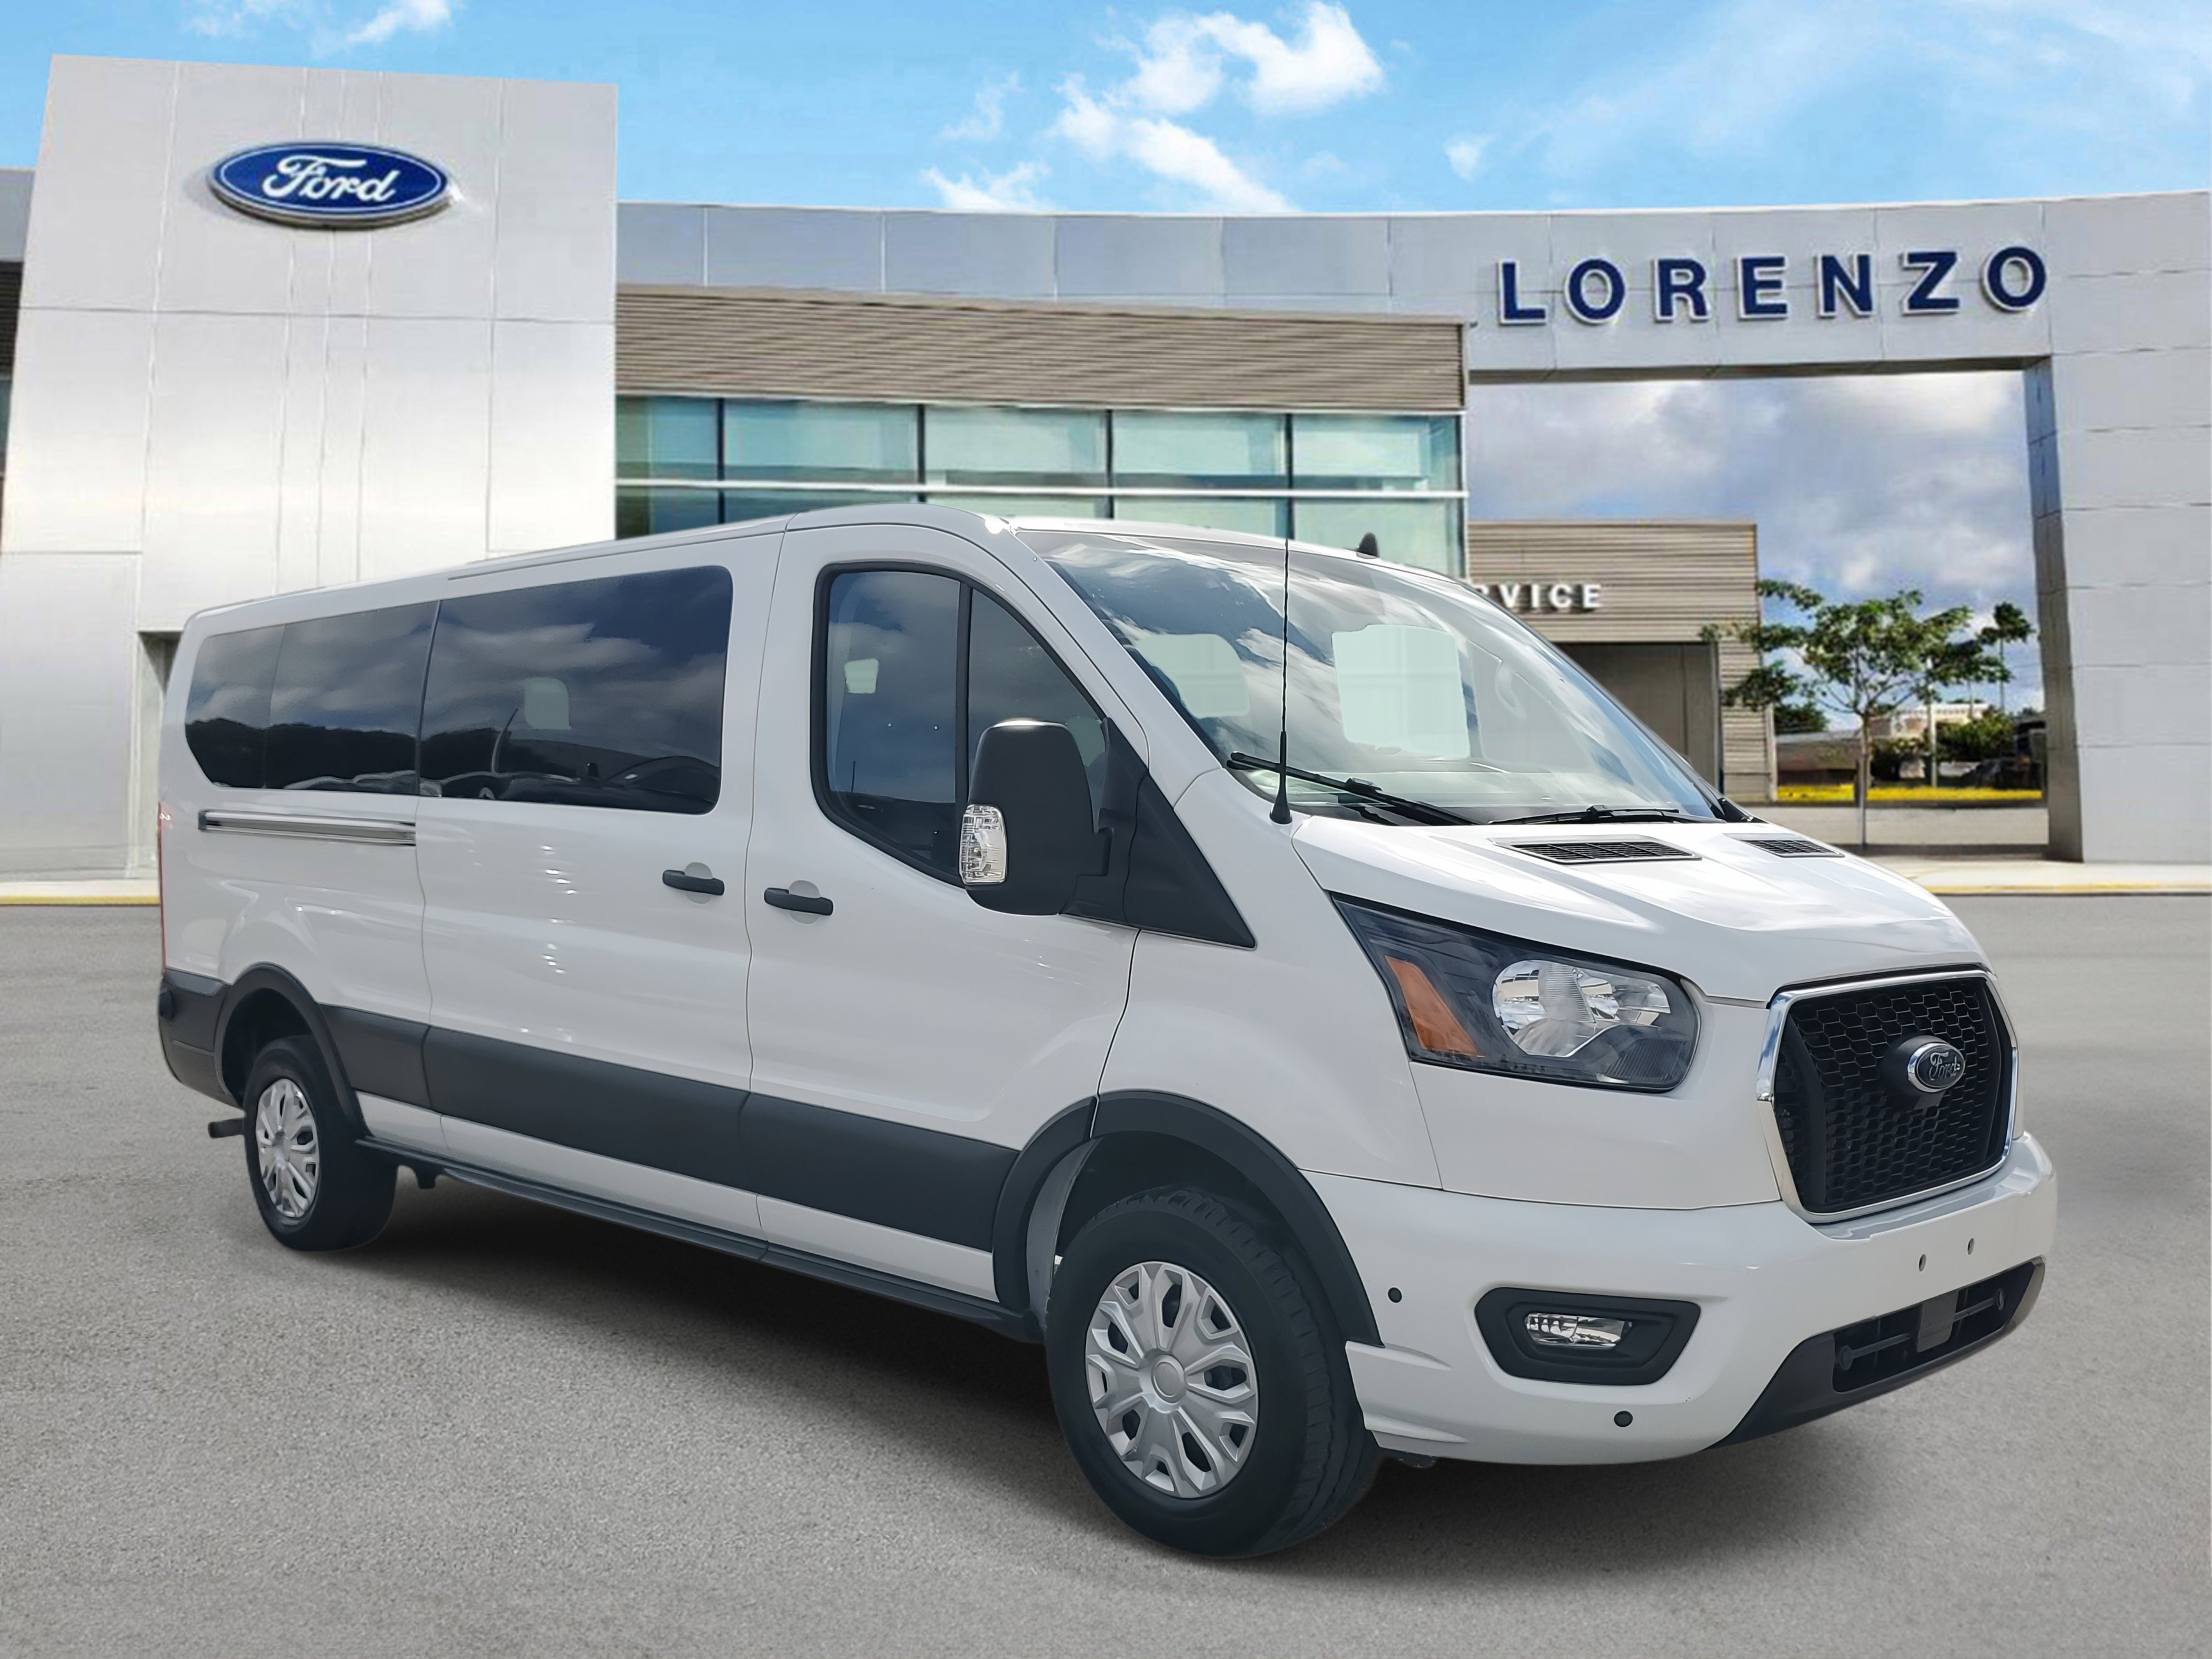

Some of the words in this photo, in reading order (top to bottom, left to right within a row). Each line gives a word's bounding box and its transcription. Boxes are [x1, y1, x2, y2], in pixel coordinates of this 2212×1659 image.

[262, 154, 401, 202] Ford
[1499, 247, 2047, 324] LORENZO
[1929, 1051, 1960, 1081] Ford
